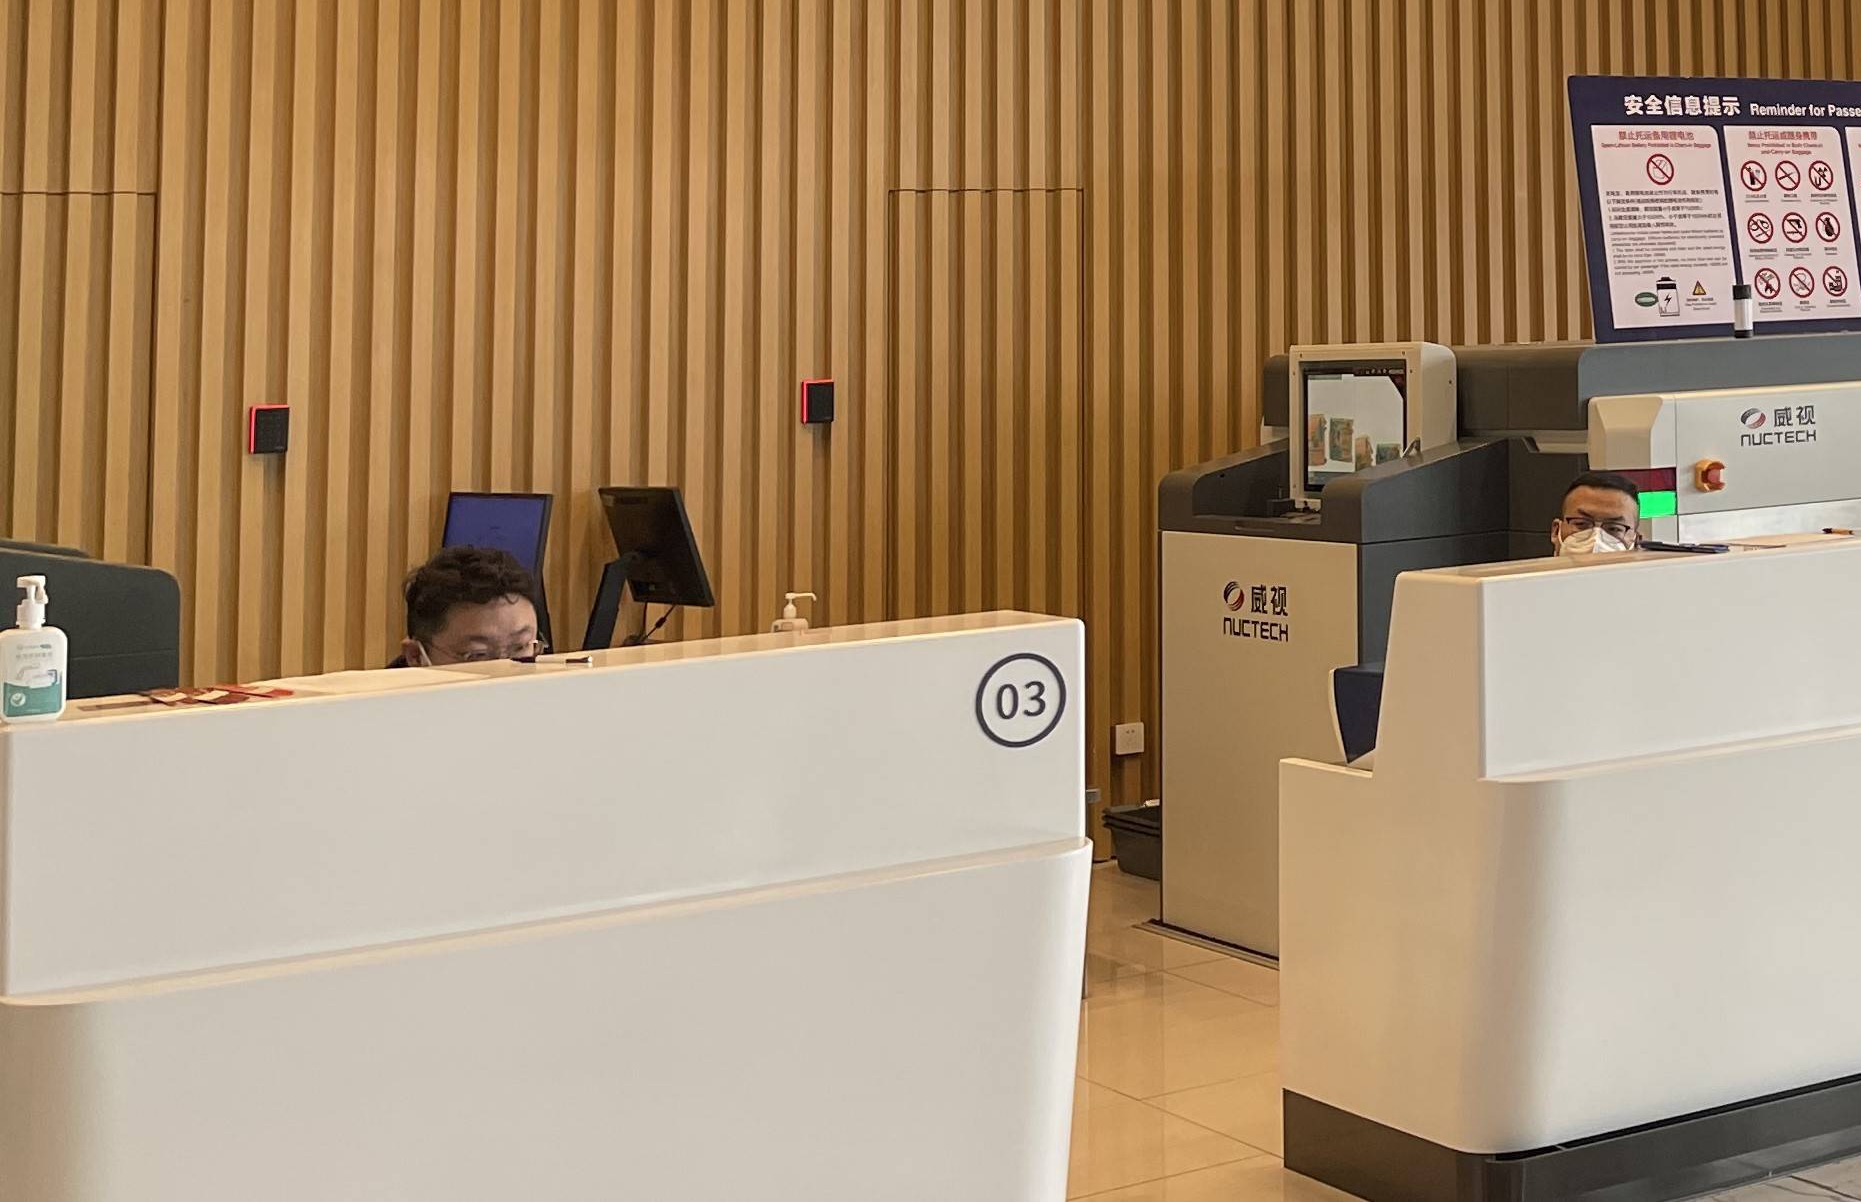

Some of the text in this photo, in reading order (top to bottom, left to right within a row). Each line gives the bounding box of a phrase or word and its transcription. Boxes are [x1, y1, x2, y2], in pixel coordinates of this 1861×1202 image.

[1624, 95, 1740, 115] 安全信息提示
[1750, 103, 1807, 117] Reminder
[1809, 104, 1826, 117] for
[1773, 405, 1816, 428] 威视
[1740, 429, 1817, 447] NUCTECH
[1251, 584, 1288, 617] 威视
[1223, 618, 1288, 642] NUCTECH
[996, 680, 1047, 719] 03
